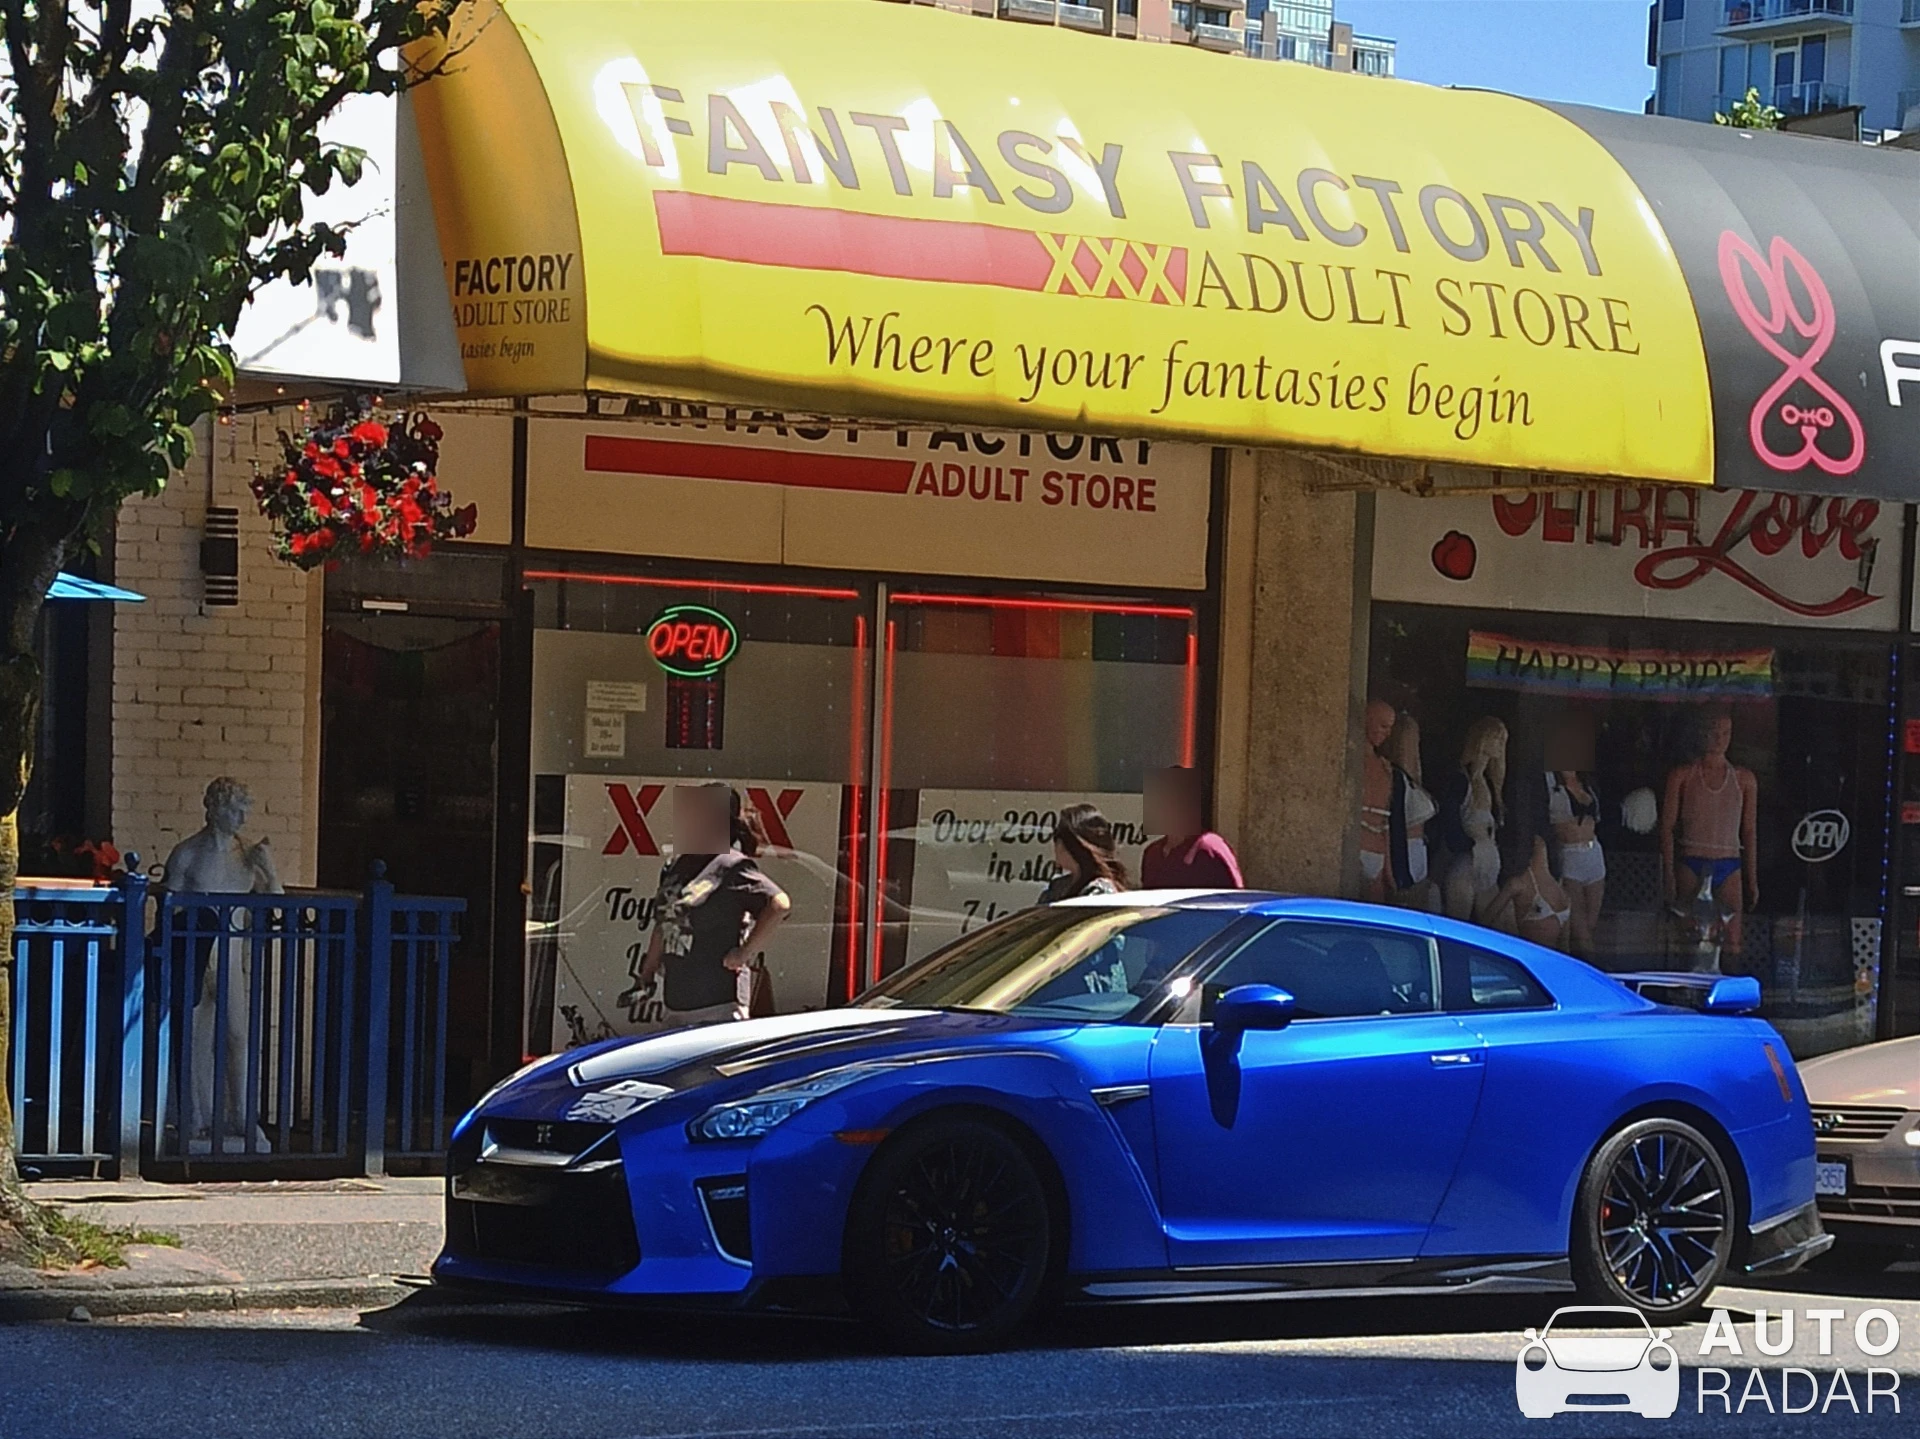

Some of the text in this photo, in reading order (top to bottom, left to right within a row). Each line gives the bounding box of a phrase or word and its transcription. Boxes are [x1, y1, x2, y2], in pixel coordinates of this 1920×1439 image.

[621, 82, 1602, 277] FANTASY FACTORY
[454, 253, 574, 297] FACTORY
[1036, 231, 1640, 356] XXX ADULT STORE
[453, 297, 571, 328] ADULT STORE
[460, 335, 535, 364] tasies begin
[806, 304, 1535, 440] Where your fantasies begin
[915, 461, 1157, 513] ADULT STORE
[649, 622, 730, 660] OPEN
[1496, 644, 1747, 690] HAPPY PRIDE
[602, 782, 805, 859] XX
[932, 808, 1060, 844] Over 200
[987, 851, 1058, 883] in sto
[605, 886, 657, 931] Toy
